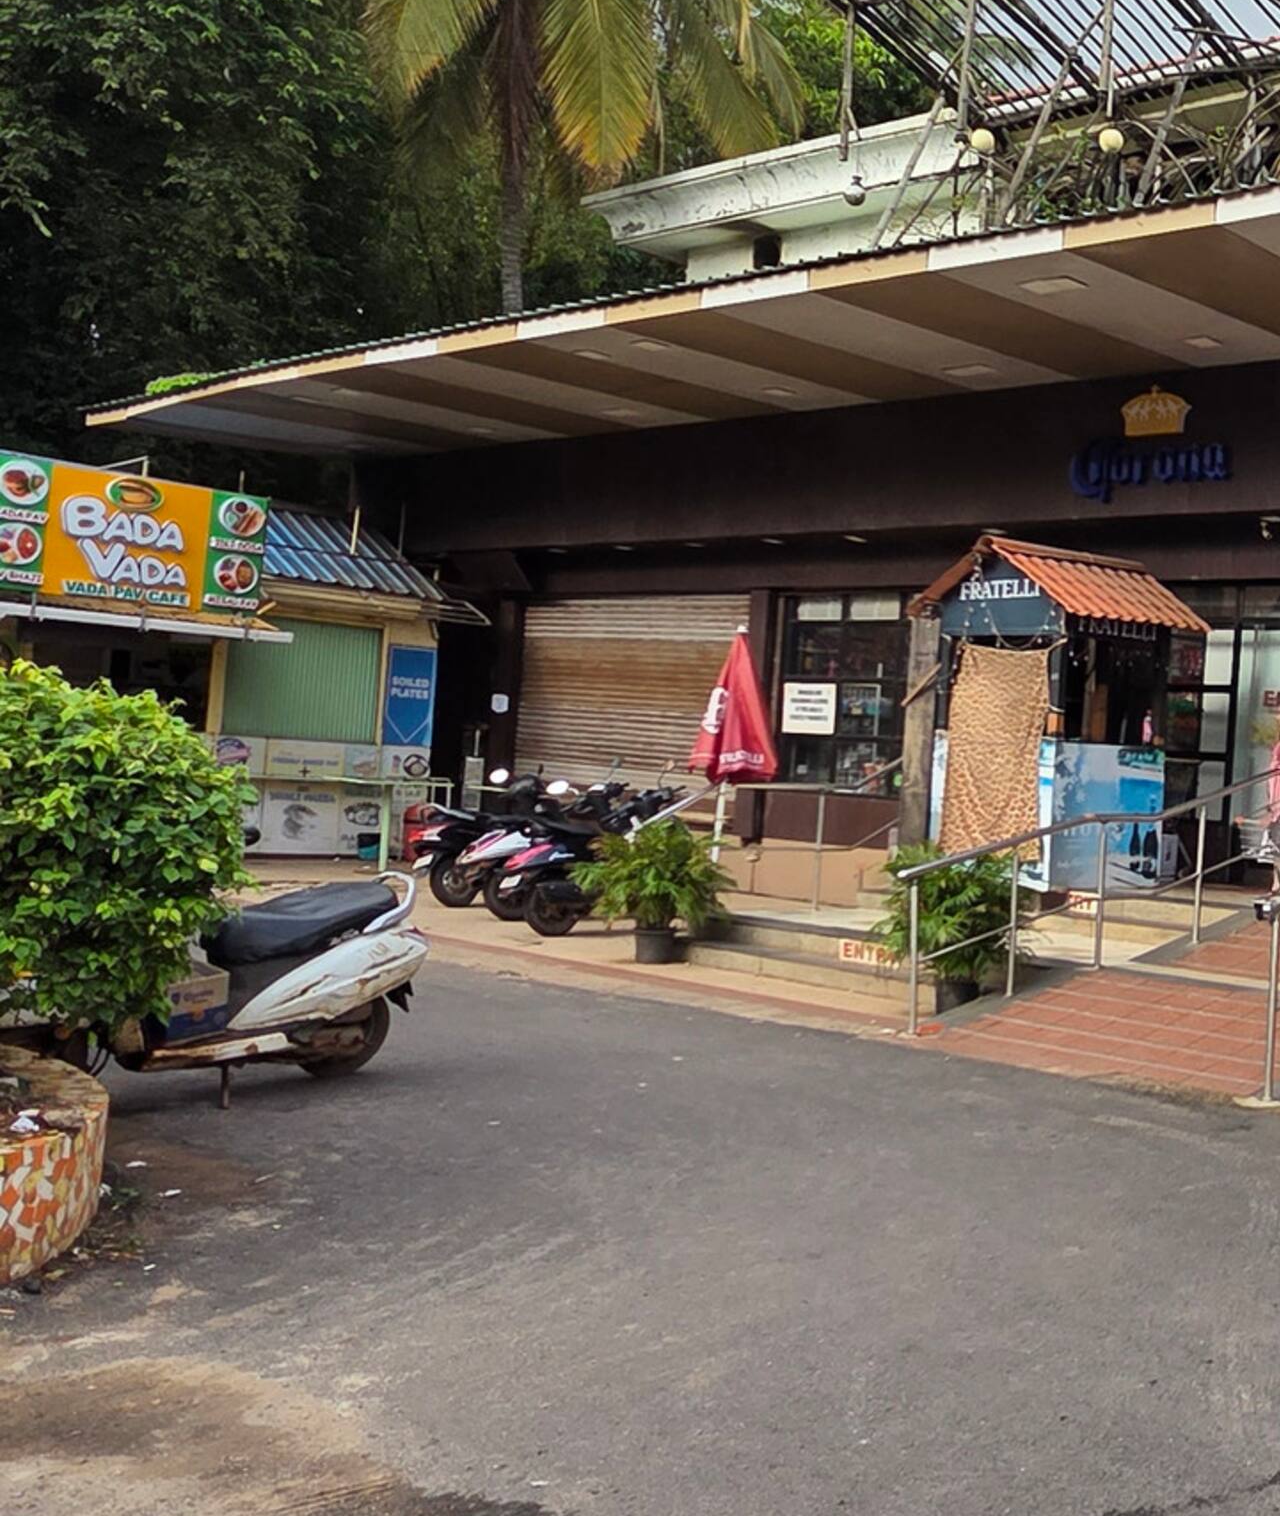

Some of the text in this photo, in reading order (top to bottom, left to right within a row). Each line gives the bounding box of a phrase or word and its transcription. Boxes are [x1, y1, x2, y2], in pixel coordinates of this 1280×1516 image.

[1070, 438, 1232, 503] Corona
[62, 495, 184, 551] BADA
[79, 539, 187, 587] VADA
[65, 581, 188, 605] VADA PAV CAFE
[959, 578, 1042, 601] FRATELLI
[391, 688, 429, 699] PLATES
[392, 676, 429, 688] SOILED
